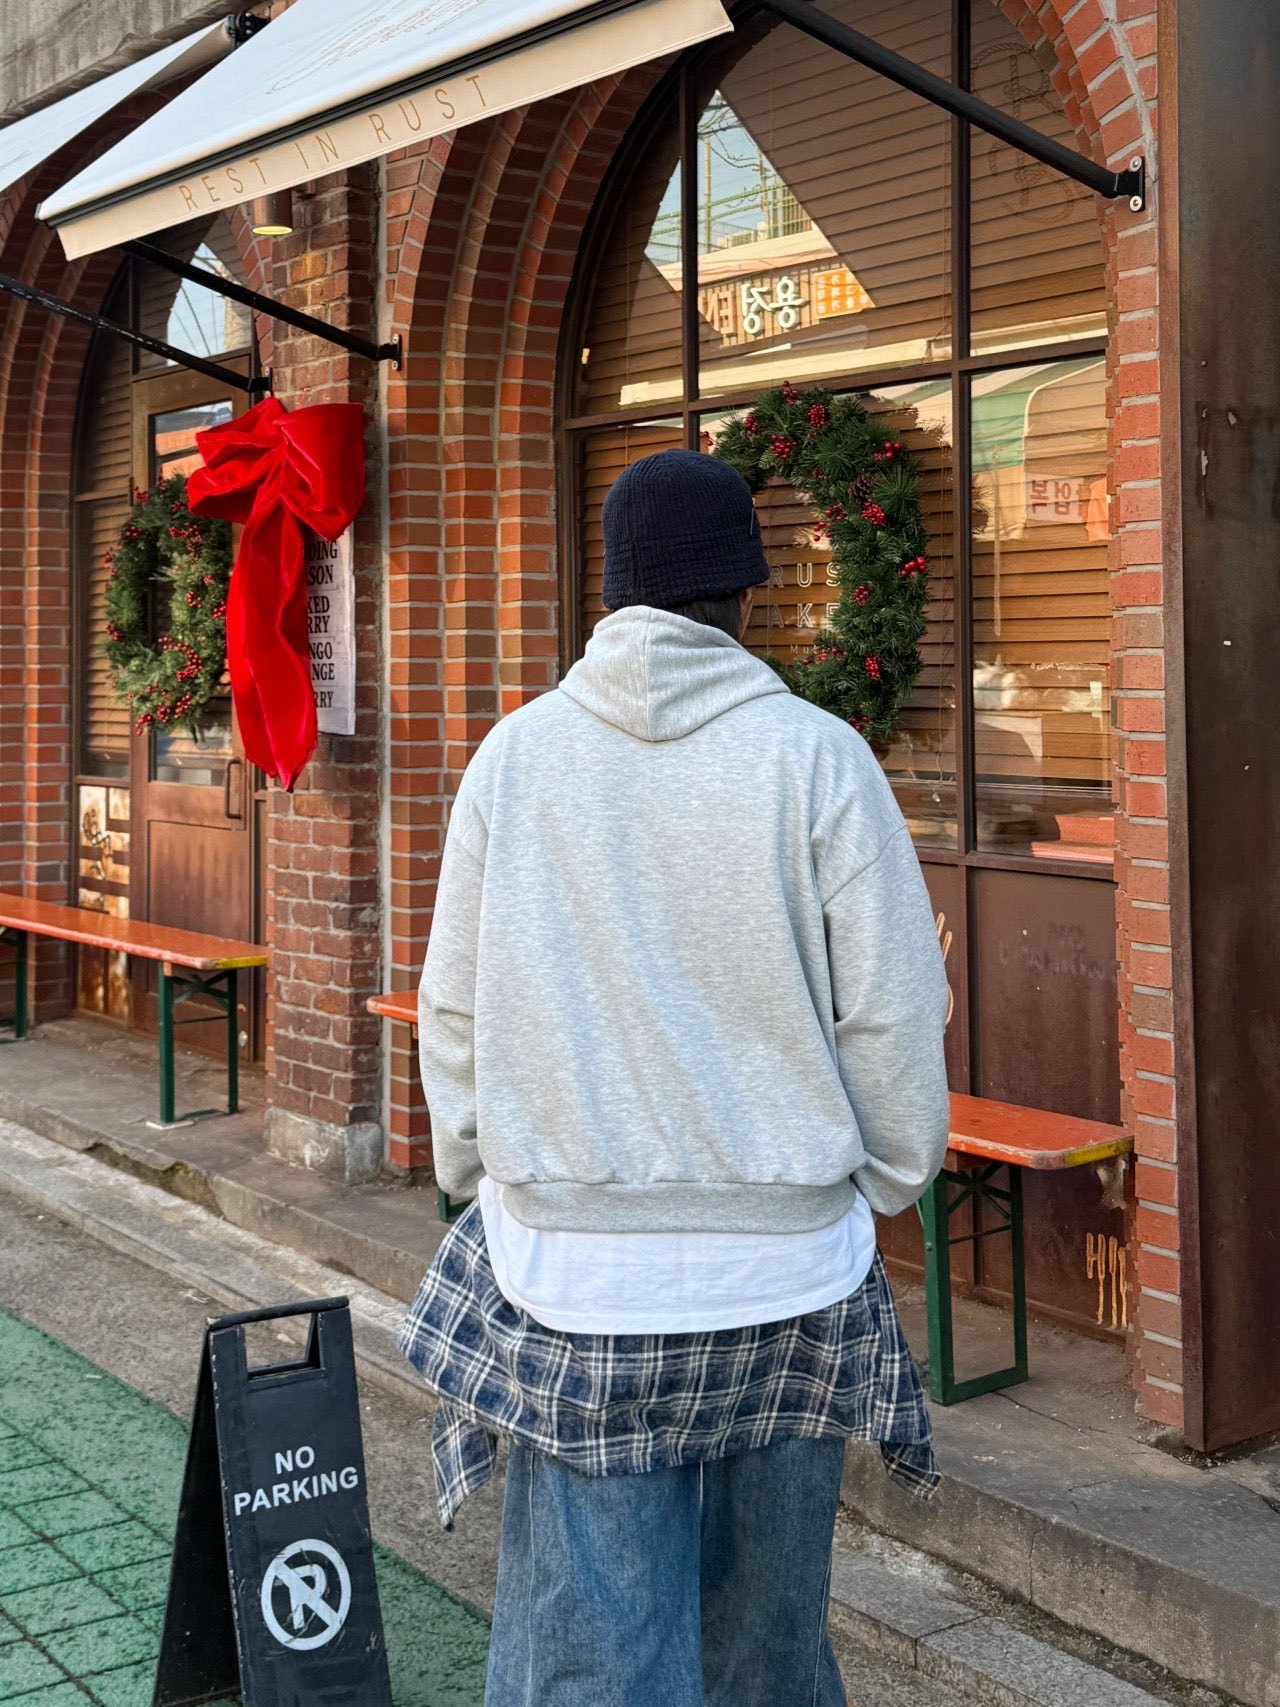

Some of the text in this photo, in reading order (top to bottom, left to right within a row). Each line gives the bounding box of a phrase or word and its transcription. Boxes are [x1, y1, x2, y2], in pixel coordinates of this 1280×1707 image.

[178, 74, 487, 211] REST IN RUST
[306, 565, 334, 586] SON
[311, 662, 335, 681] NGE
[274, 1445, 315, 1475] NO
[233, 1466, 359, 1516] PARKING
